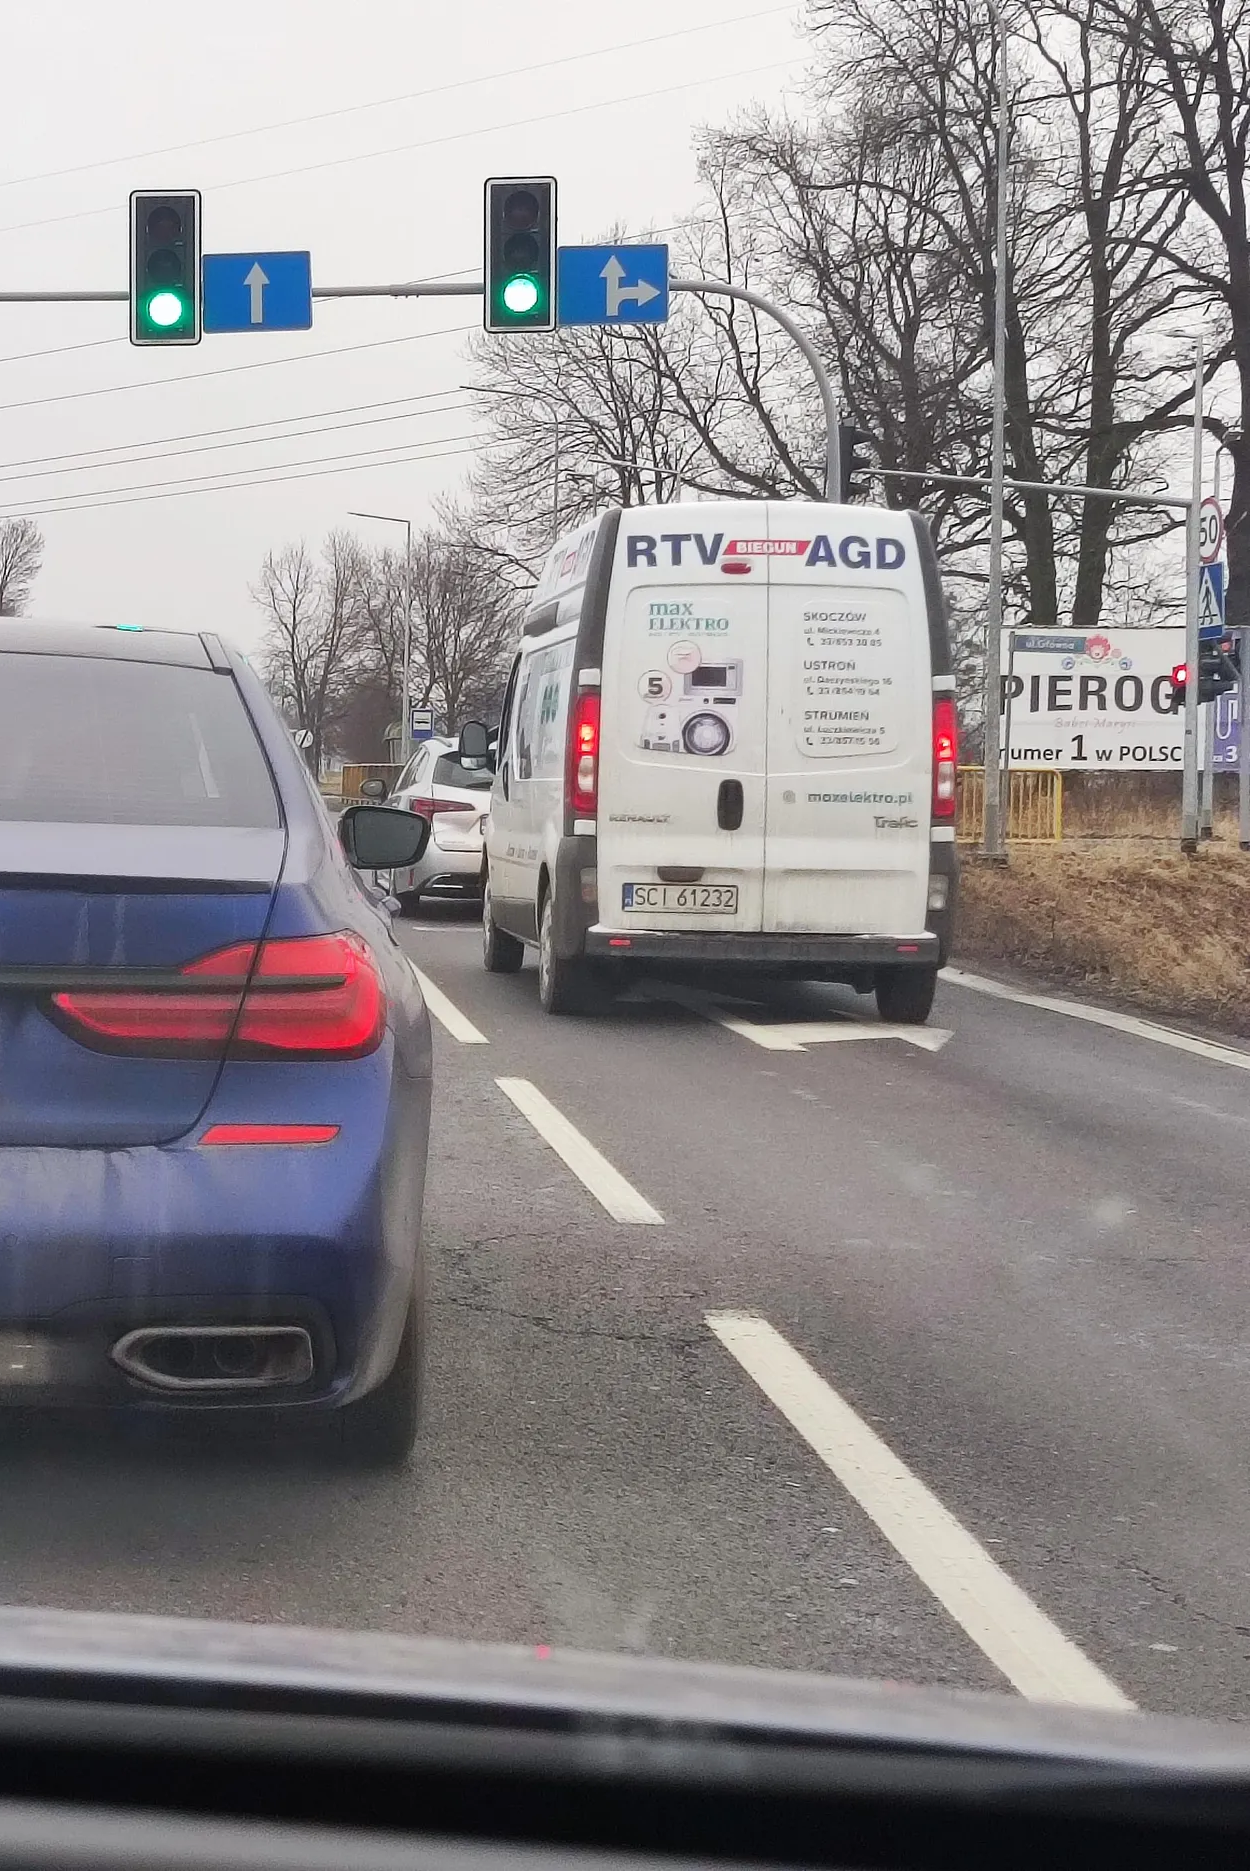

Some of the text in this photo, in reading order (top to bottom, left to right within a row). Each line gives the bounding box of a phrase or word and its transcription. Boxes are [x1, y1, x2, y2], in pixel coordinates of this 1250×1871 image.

[1200, 514, 1218, 547] 50
[626, 533, 724, 568] RTV
[736, 541, 798, 555] BIEGUN
[805, 535, 906, 570] AGD
[649, 602, 694, 616] max
[803, 610, 867, 622] SKOCZÓW
[648, 617, 730, 631] ELEKTRO
[803, 659, 856, 671] USTROŃ
[648, 677, 664, 695] 5
[999, 675, 1180, 715] PIEROG
[804, 710, 869, 721] STRUMIEŃ
[1071, 735, 1088, 760] 1
[1096, 750, 1113, 761] w
[1119, 746, 1182, 762] POLSC
[807, 791, 913, 806] maxelektro.pl
[873, 815, 919, 829] Trafic
[635, 887, 667, 906] SCI
[677, 889, 734, 908] 61232
